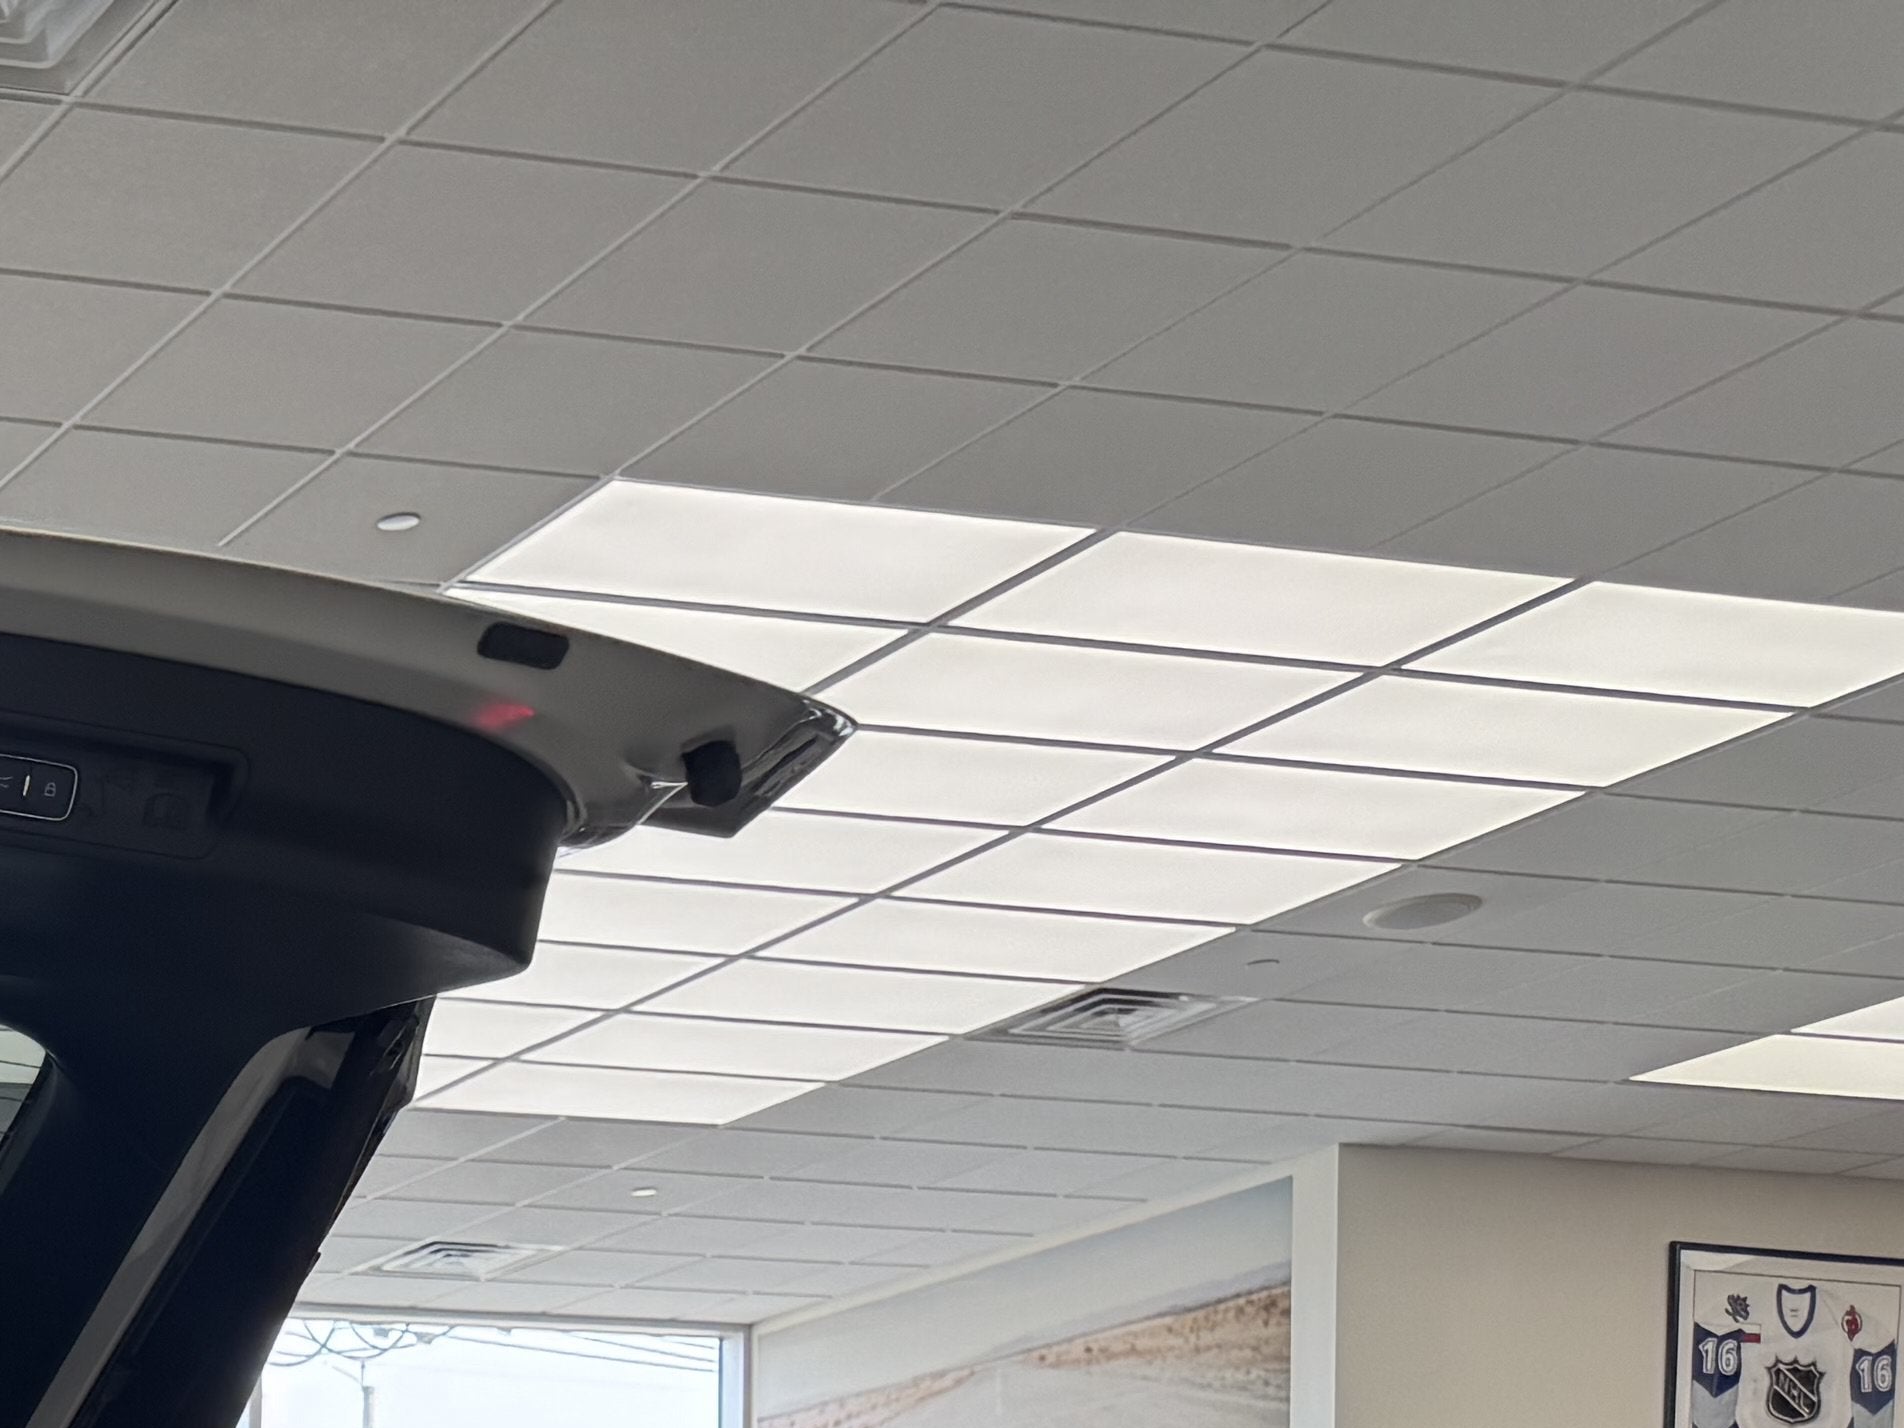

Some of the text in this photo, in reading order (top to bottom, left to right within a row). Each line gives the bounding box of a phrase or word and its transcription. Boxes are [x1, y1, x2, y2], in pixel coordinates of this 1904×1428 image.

[1698, 1337, 1739, 1376] 16
[1855, 1355, 1892, 1392] 16
[1777, 1375, 1810, 1413] NHL
